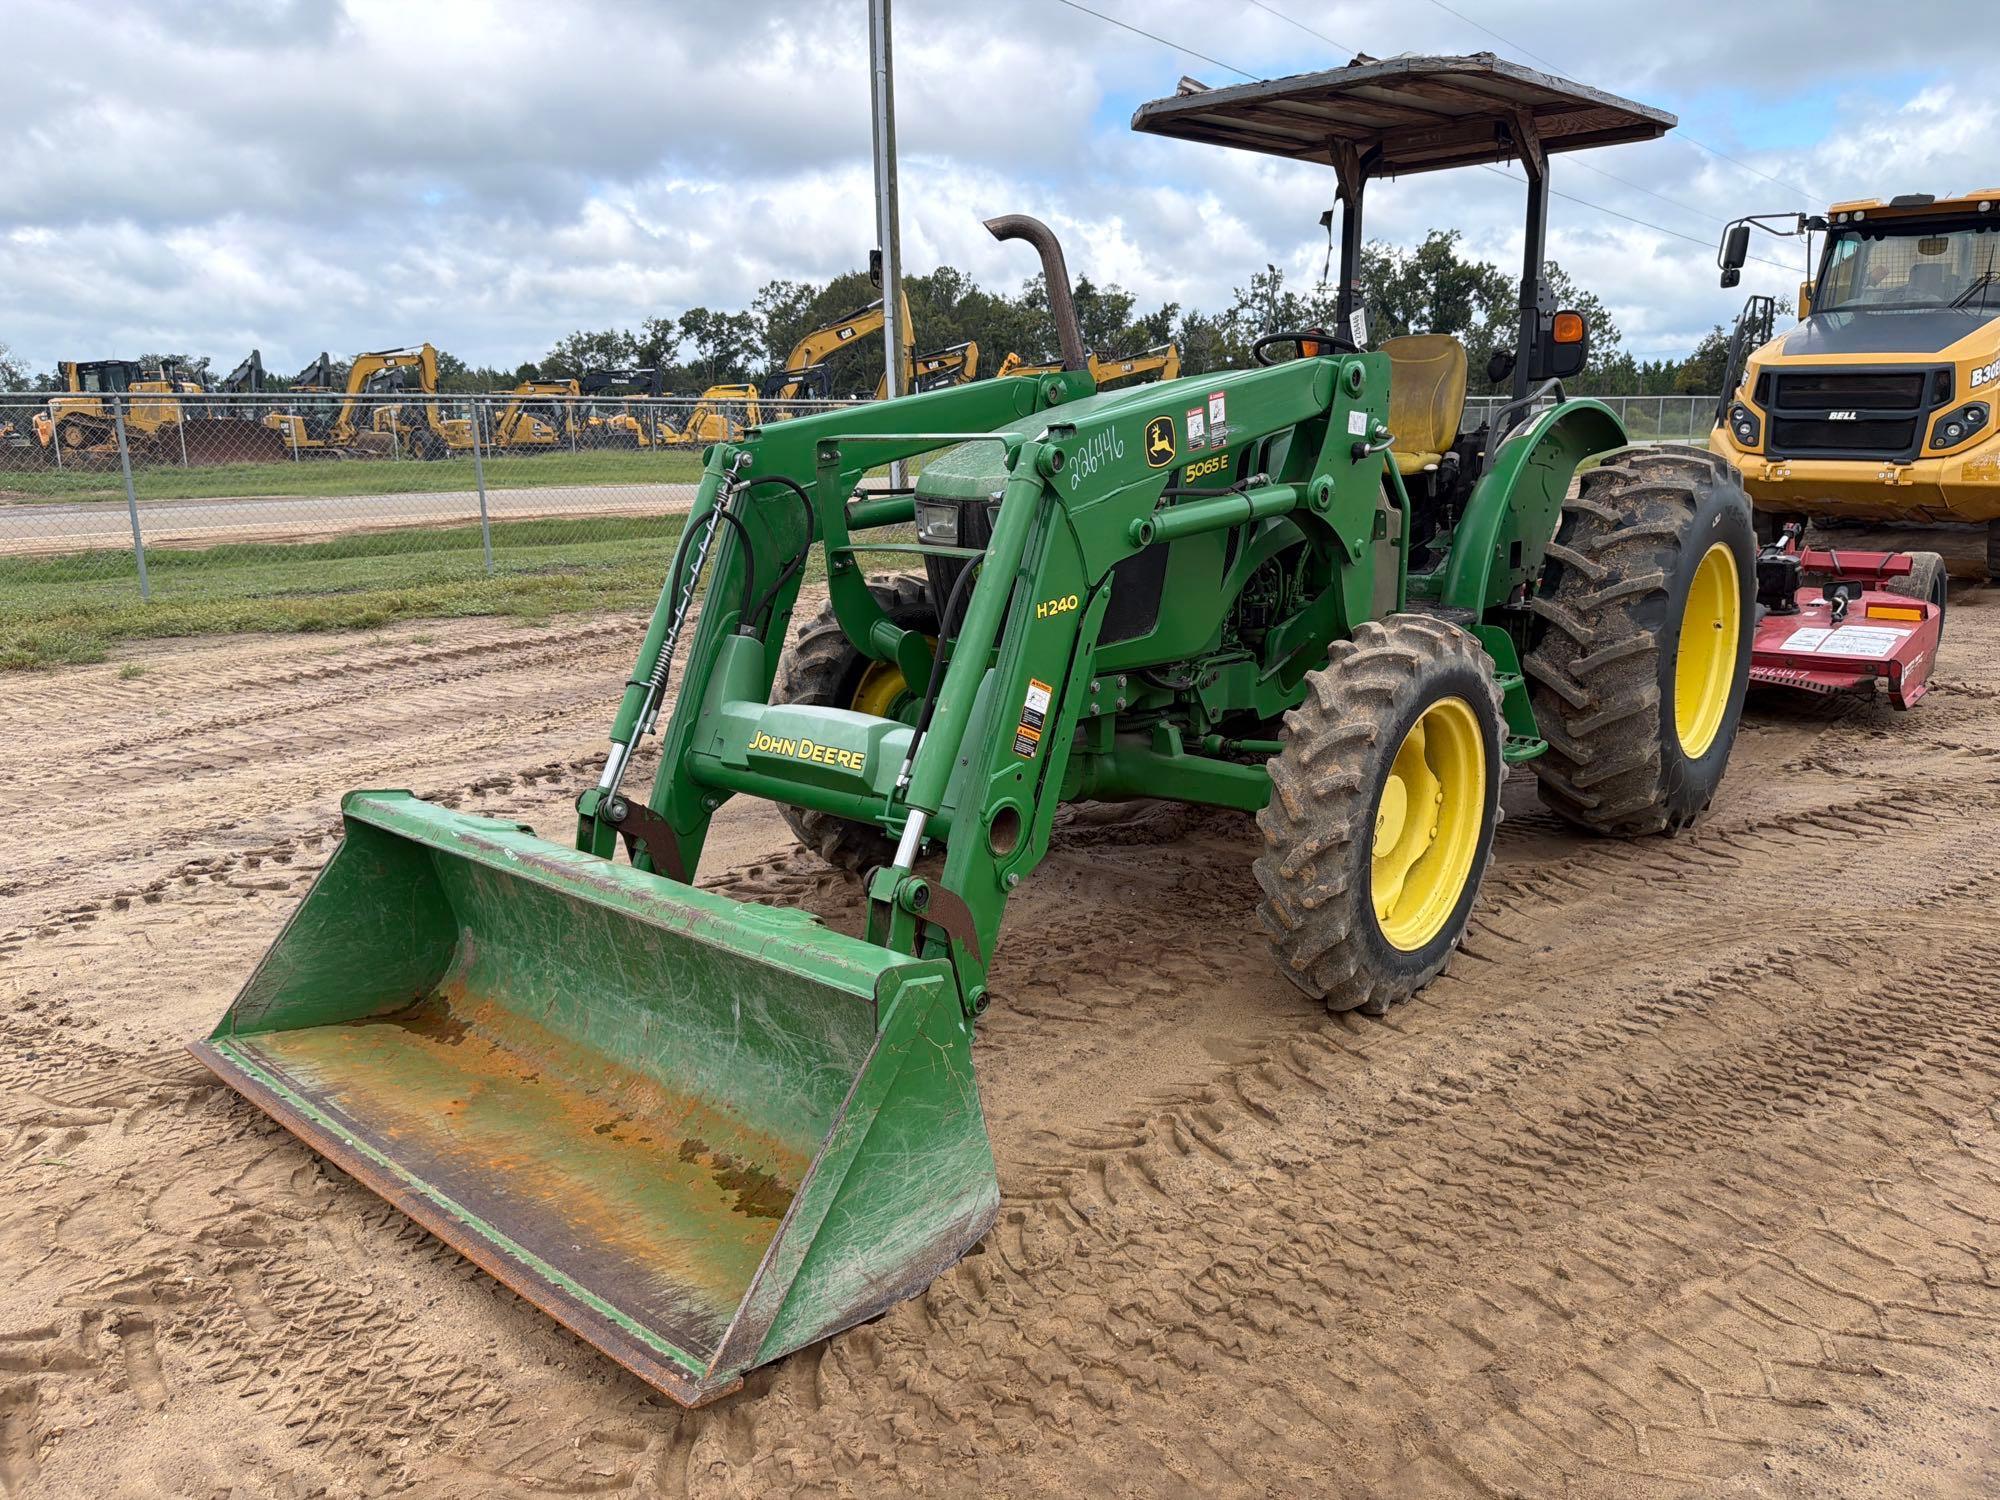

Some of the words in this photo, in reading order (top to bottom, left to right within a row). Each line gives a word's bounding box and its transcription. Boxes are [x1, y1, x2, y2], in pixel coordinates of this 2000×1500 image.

[840, 329, 852, 339] CAT
[1828, 411, 1857, 420] BELL
[1069, 424, 1123, 490] 226446
[1752, 666, 1810, 679] 226447
[748, 730, 797, 757] JOHN
[797, 737, 865, 770] DEERE
